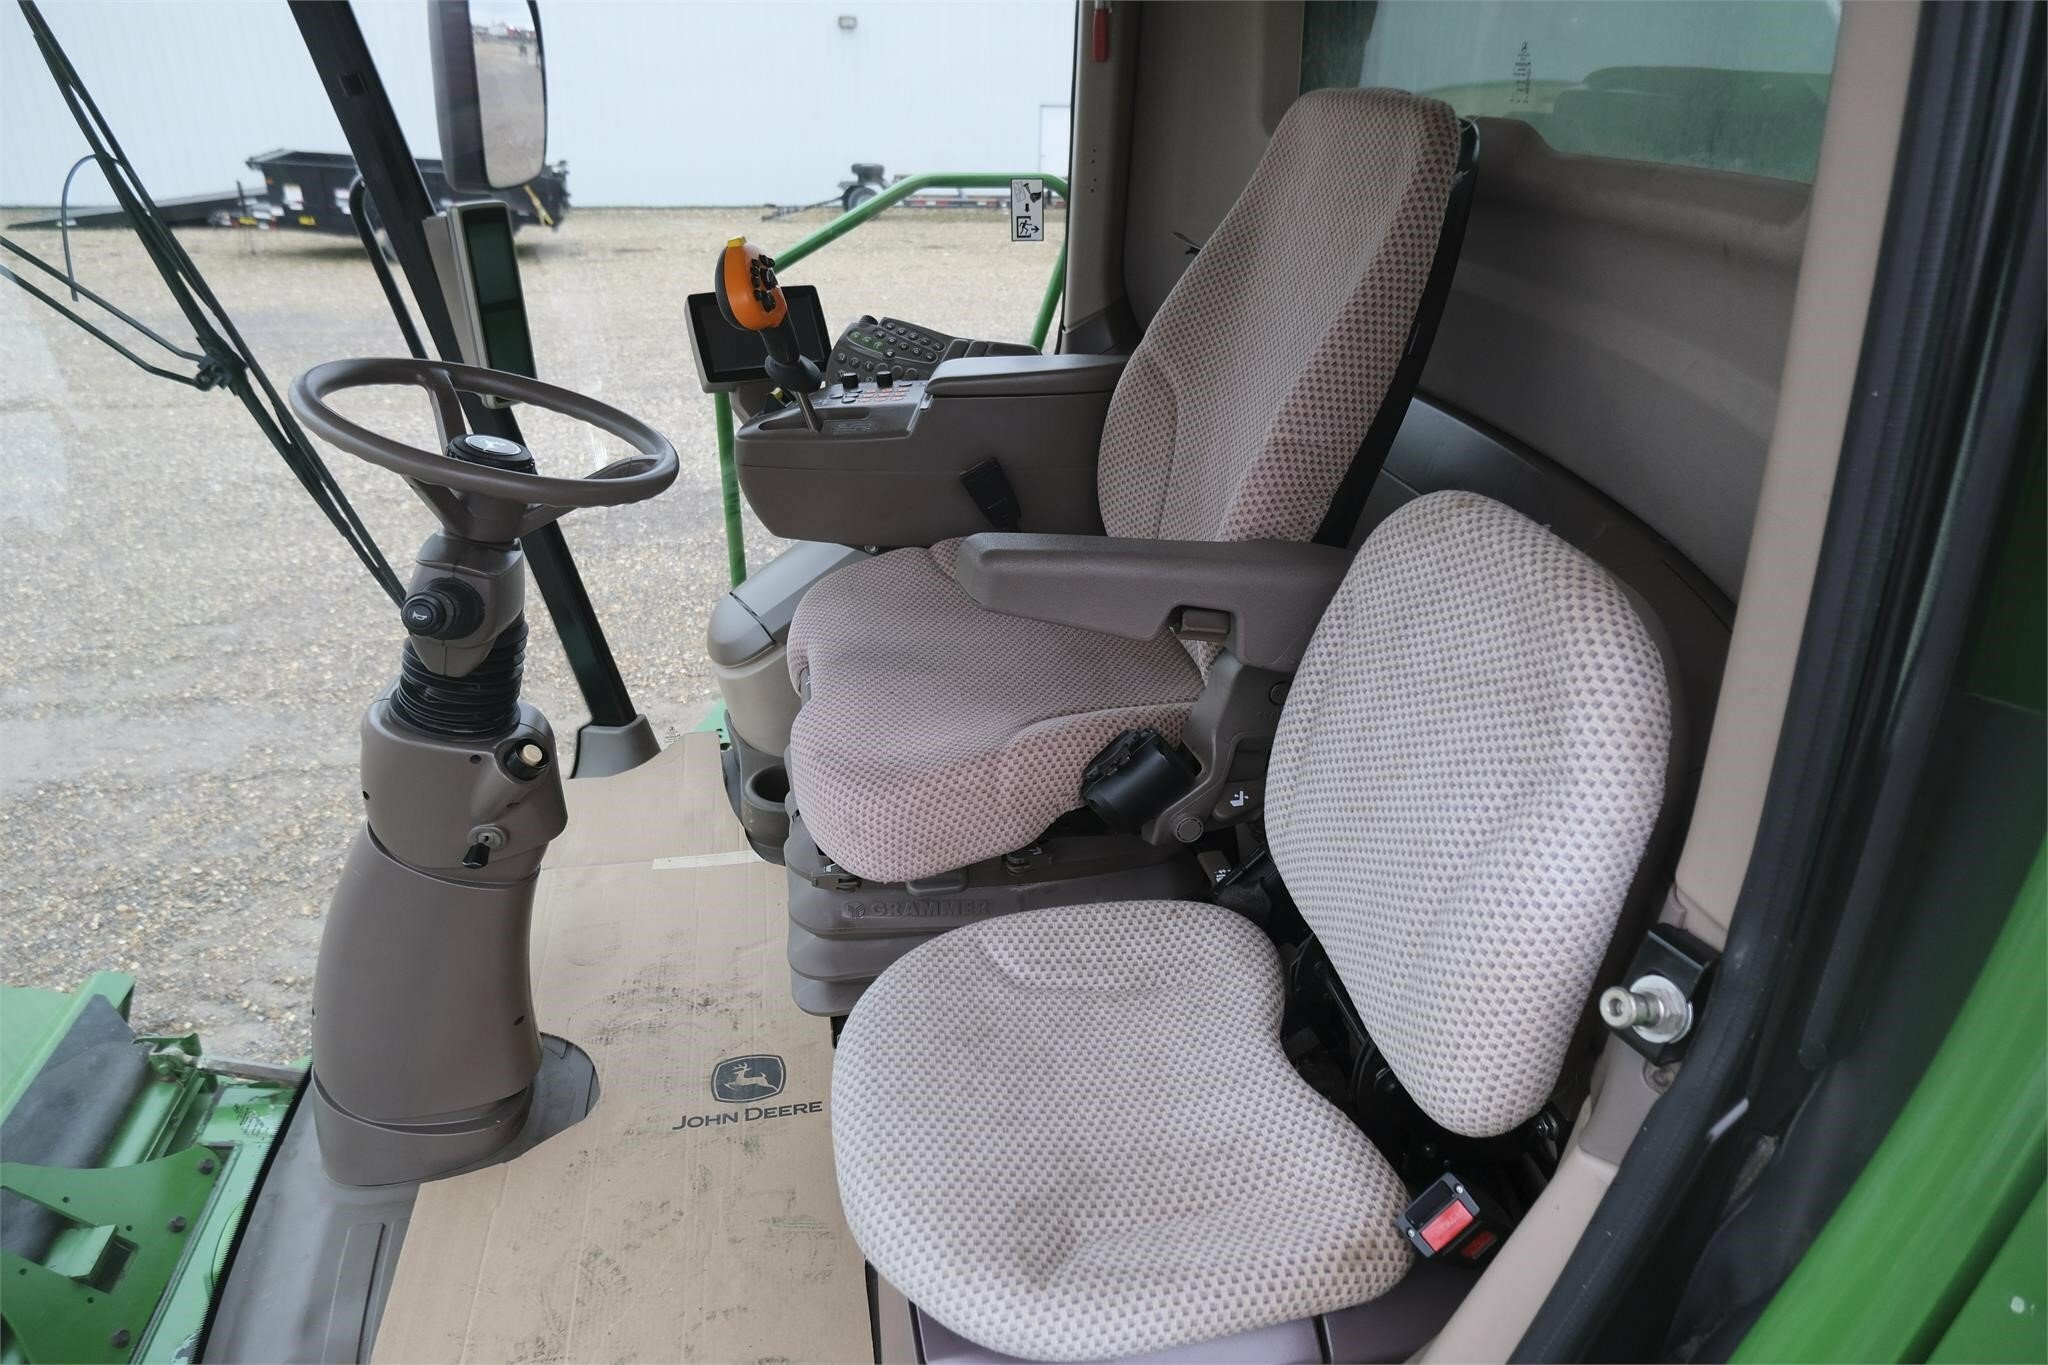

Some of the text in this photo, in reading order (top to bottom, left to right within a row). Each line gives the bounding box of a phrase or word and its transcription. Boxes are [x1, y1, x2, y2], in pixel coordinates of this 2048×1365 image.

[871, 899, 991, 917] GRAMMER
[672, 1101, 823, 1130] JOHN DEERE
